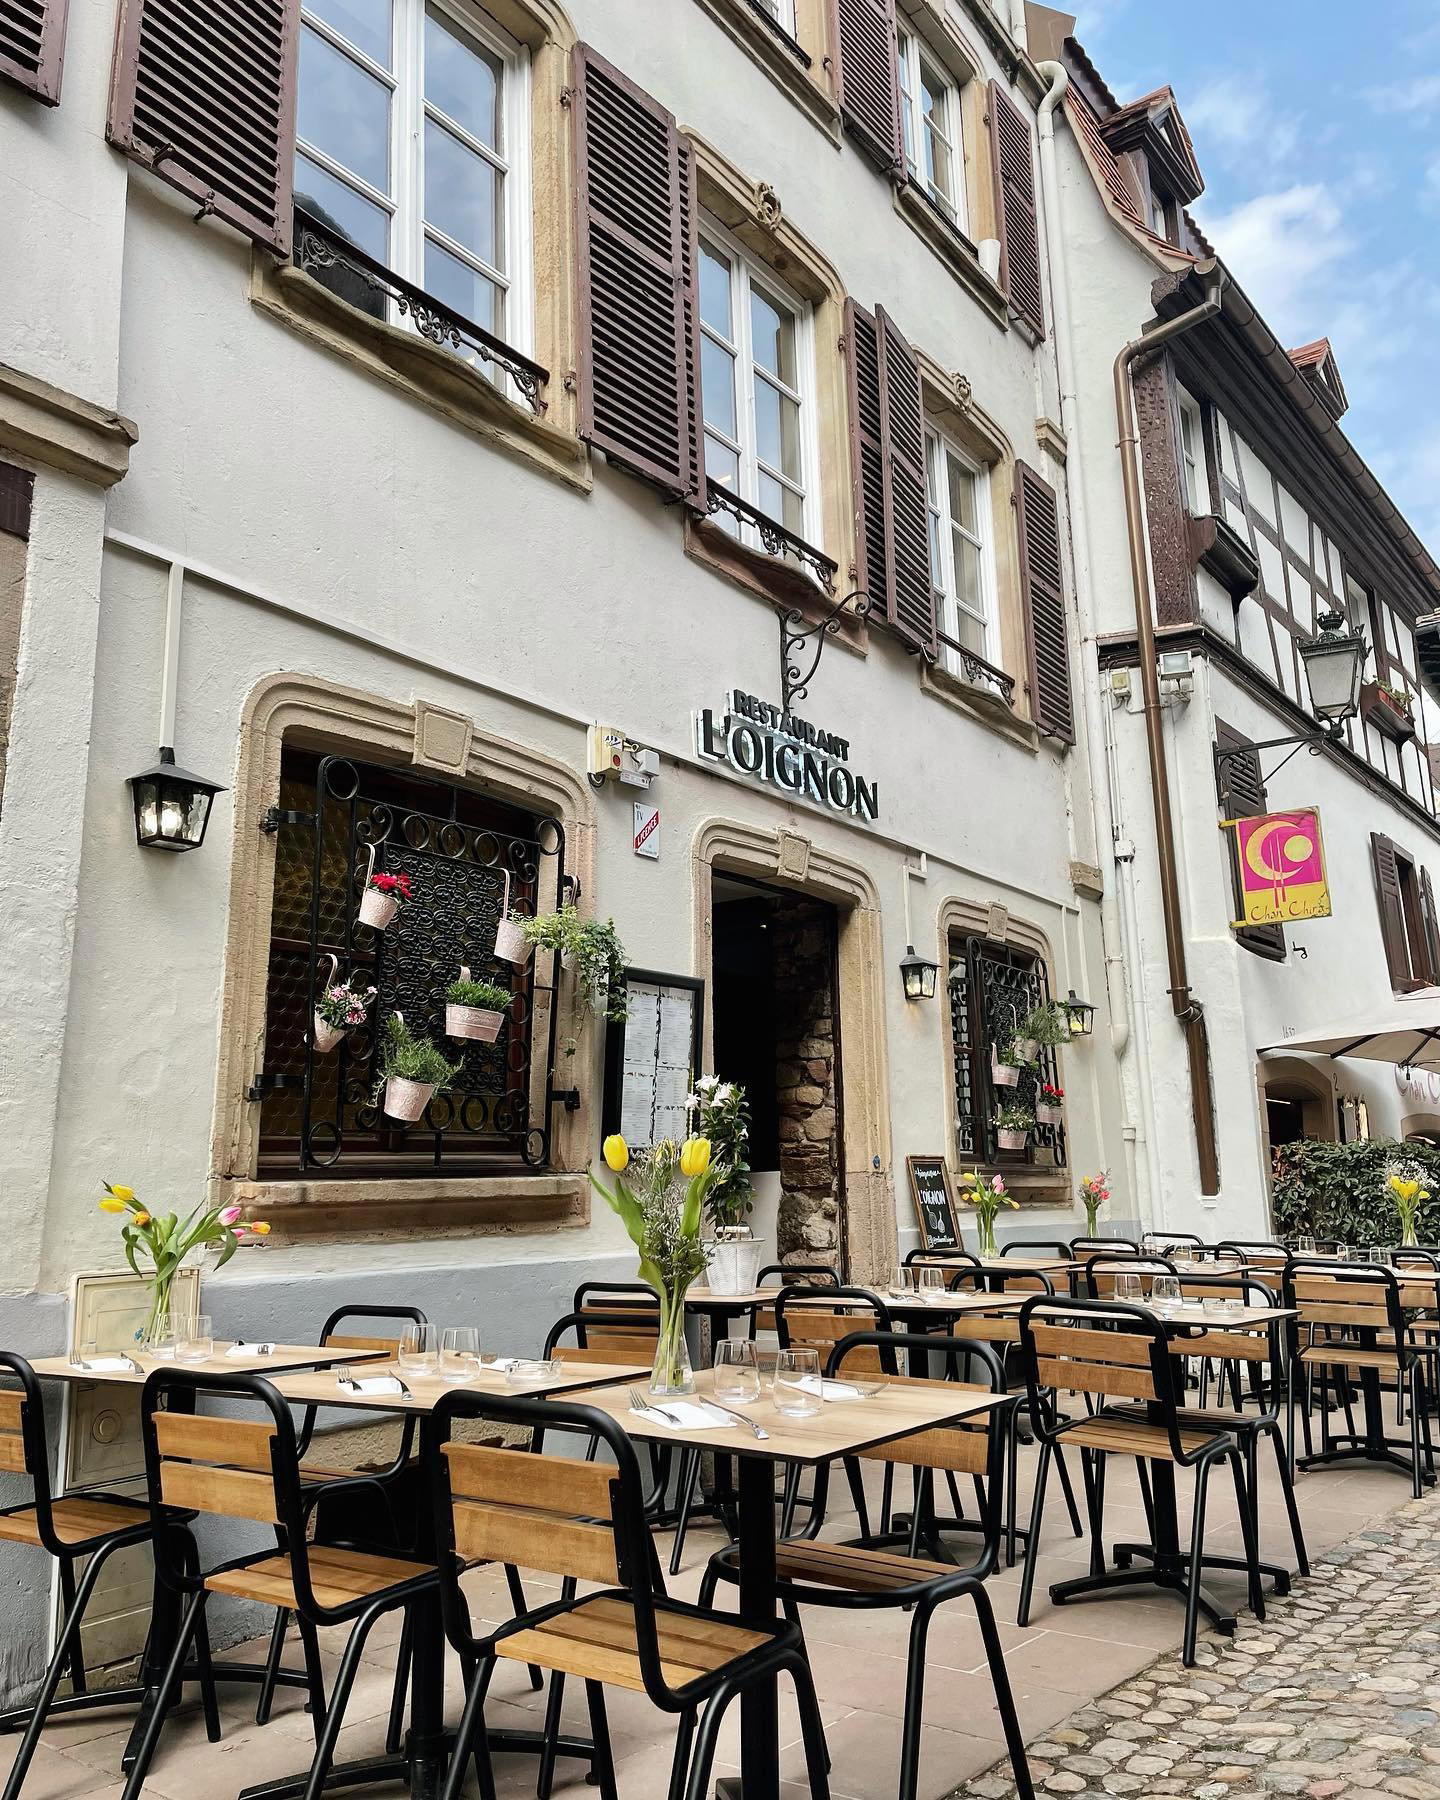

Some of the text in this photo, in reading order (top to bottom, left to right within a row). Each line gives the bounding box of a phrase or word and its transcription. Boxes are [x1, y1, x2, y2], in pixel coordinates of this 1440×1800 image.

[731, 688, 850, 762] RESTAURANT
[699, 708, 879, 820] L'OIGNON
[637, 815, 658, 844] LICENCE
[1250, 905, 1284, 921] Chan
